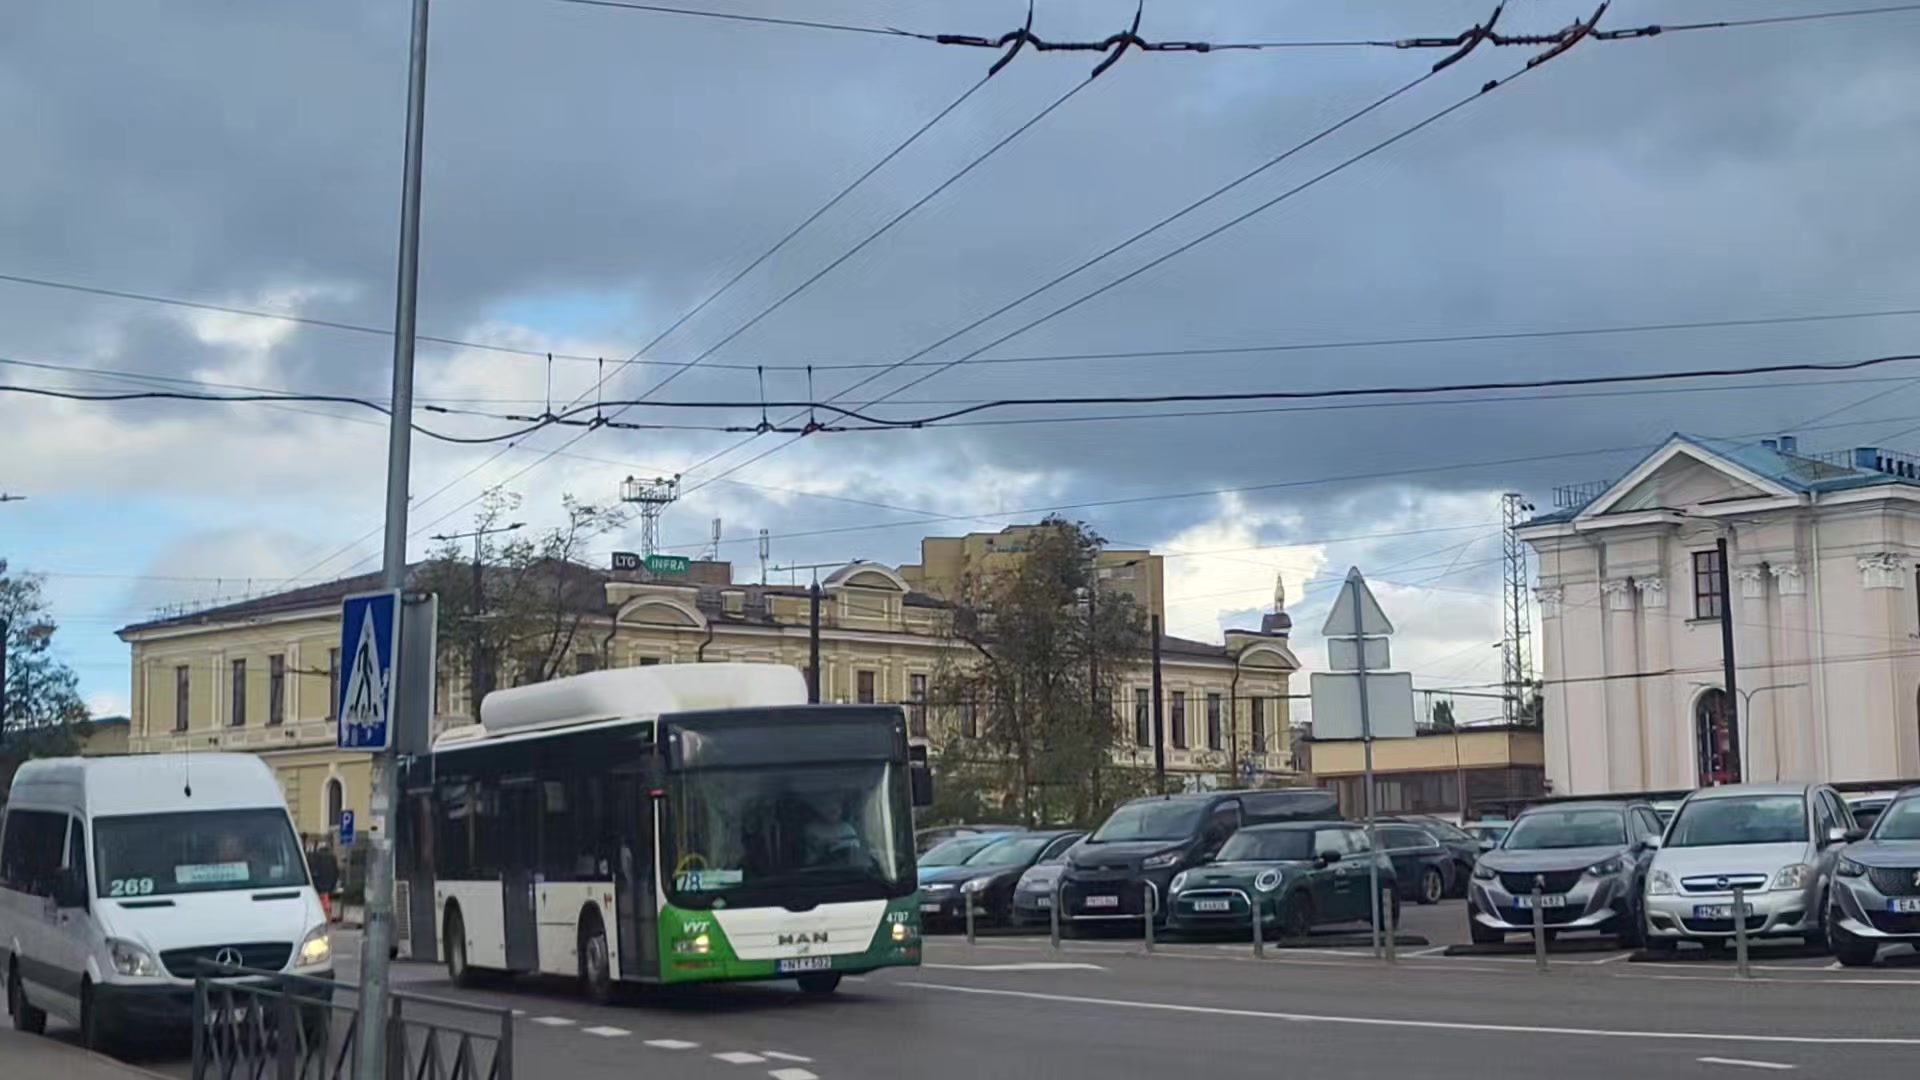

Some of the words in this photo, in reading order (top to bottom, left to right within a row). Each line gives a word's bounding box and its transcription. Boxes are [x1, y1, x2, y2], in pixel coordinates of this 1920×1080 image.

[615, 555, 636, 568] LTG
[651, 559, 685, 571] INFRA
[343, 812, 352, 828] P
[110, 877, 154, 896] 269
[778, 931, 829, 945] MAN
